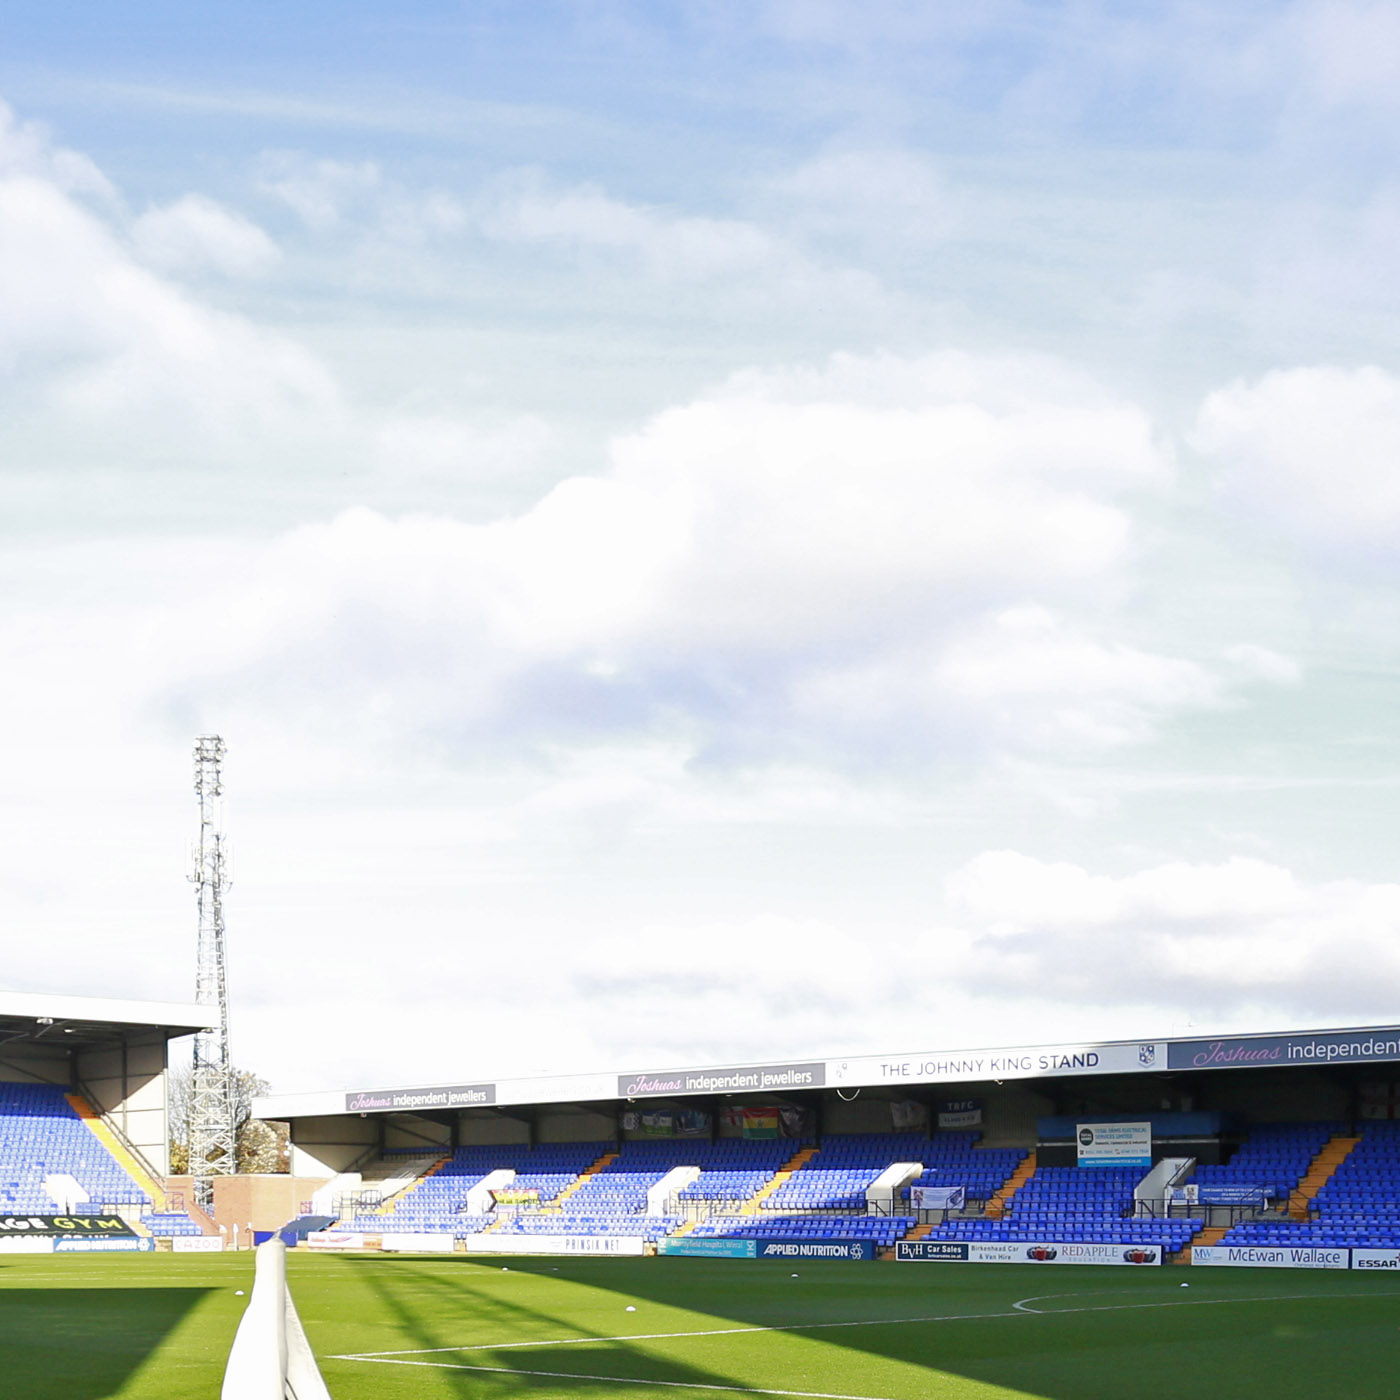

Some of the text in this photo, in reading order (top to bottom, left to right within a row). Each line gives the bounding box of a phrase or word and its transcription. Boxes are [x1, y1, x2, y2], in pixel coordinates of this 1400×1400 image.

[1193, 1041, 1282, 1067] Joshuas
[880, 1053, 1099, 1077] THE JOHNNY KING STAND
[627, 1076, 682, 1095] Joshuas
[685, 1073, 759, 1091] independent
[760, 1070, 812, 1088] jewellers
[350, 1094, 392, 1110] Joshuas
[393, 1092, 447, 1108] independent
[447, 1090, 487, 1103] jewellers
[52, 1217, 123, 1230] GYM
[56, 1240, 138, 1251] APPLIED NUTRITION
[175, 1239, 220, 1249] CAZOO
[764, 1244, 848, 1257] APPLIED NUTRITION
[902, 1243, 962, 1258] BvH Car Sales
[1194, 1248, 1213, 1257] MW
[1228, 1248, 1341, 1264] McEwan Wallace
[1358, 1260, 1398, 1268] ESSAR
